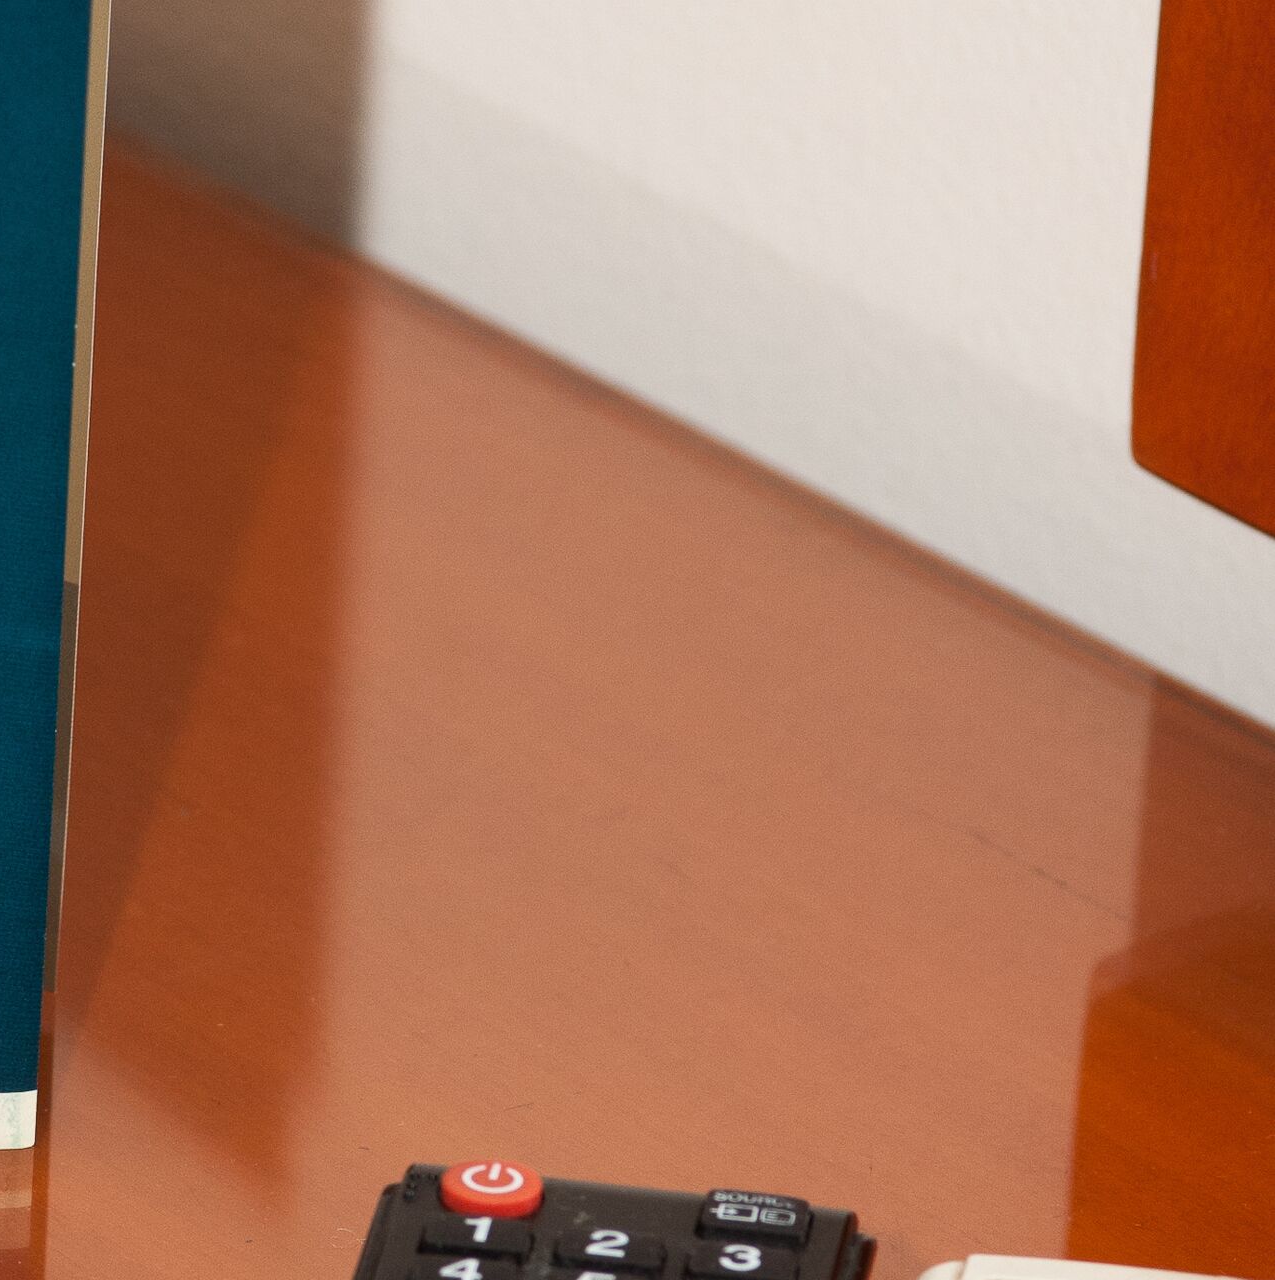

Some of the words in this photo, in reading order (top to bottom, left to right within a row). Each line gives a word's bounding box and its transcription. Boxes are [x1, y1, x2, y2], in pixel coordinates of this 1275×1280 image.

[465, 1217, 492, 1242] 1
[585, 1230, 629, 1258] 2
[719, 1244, 762, 1271] 3
